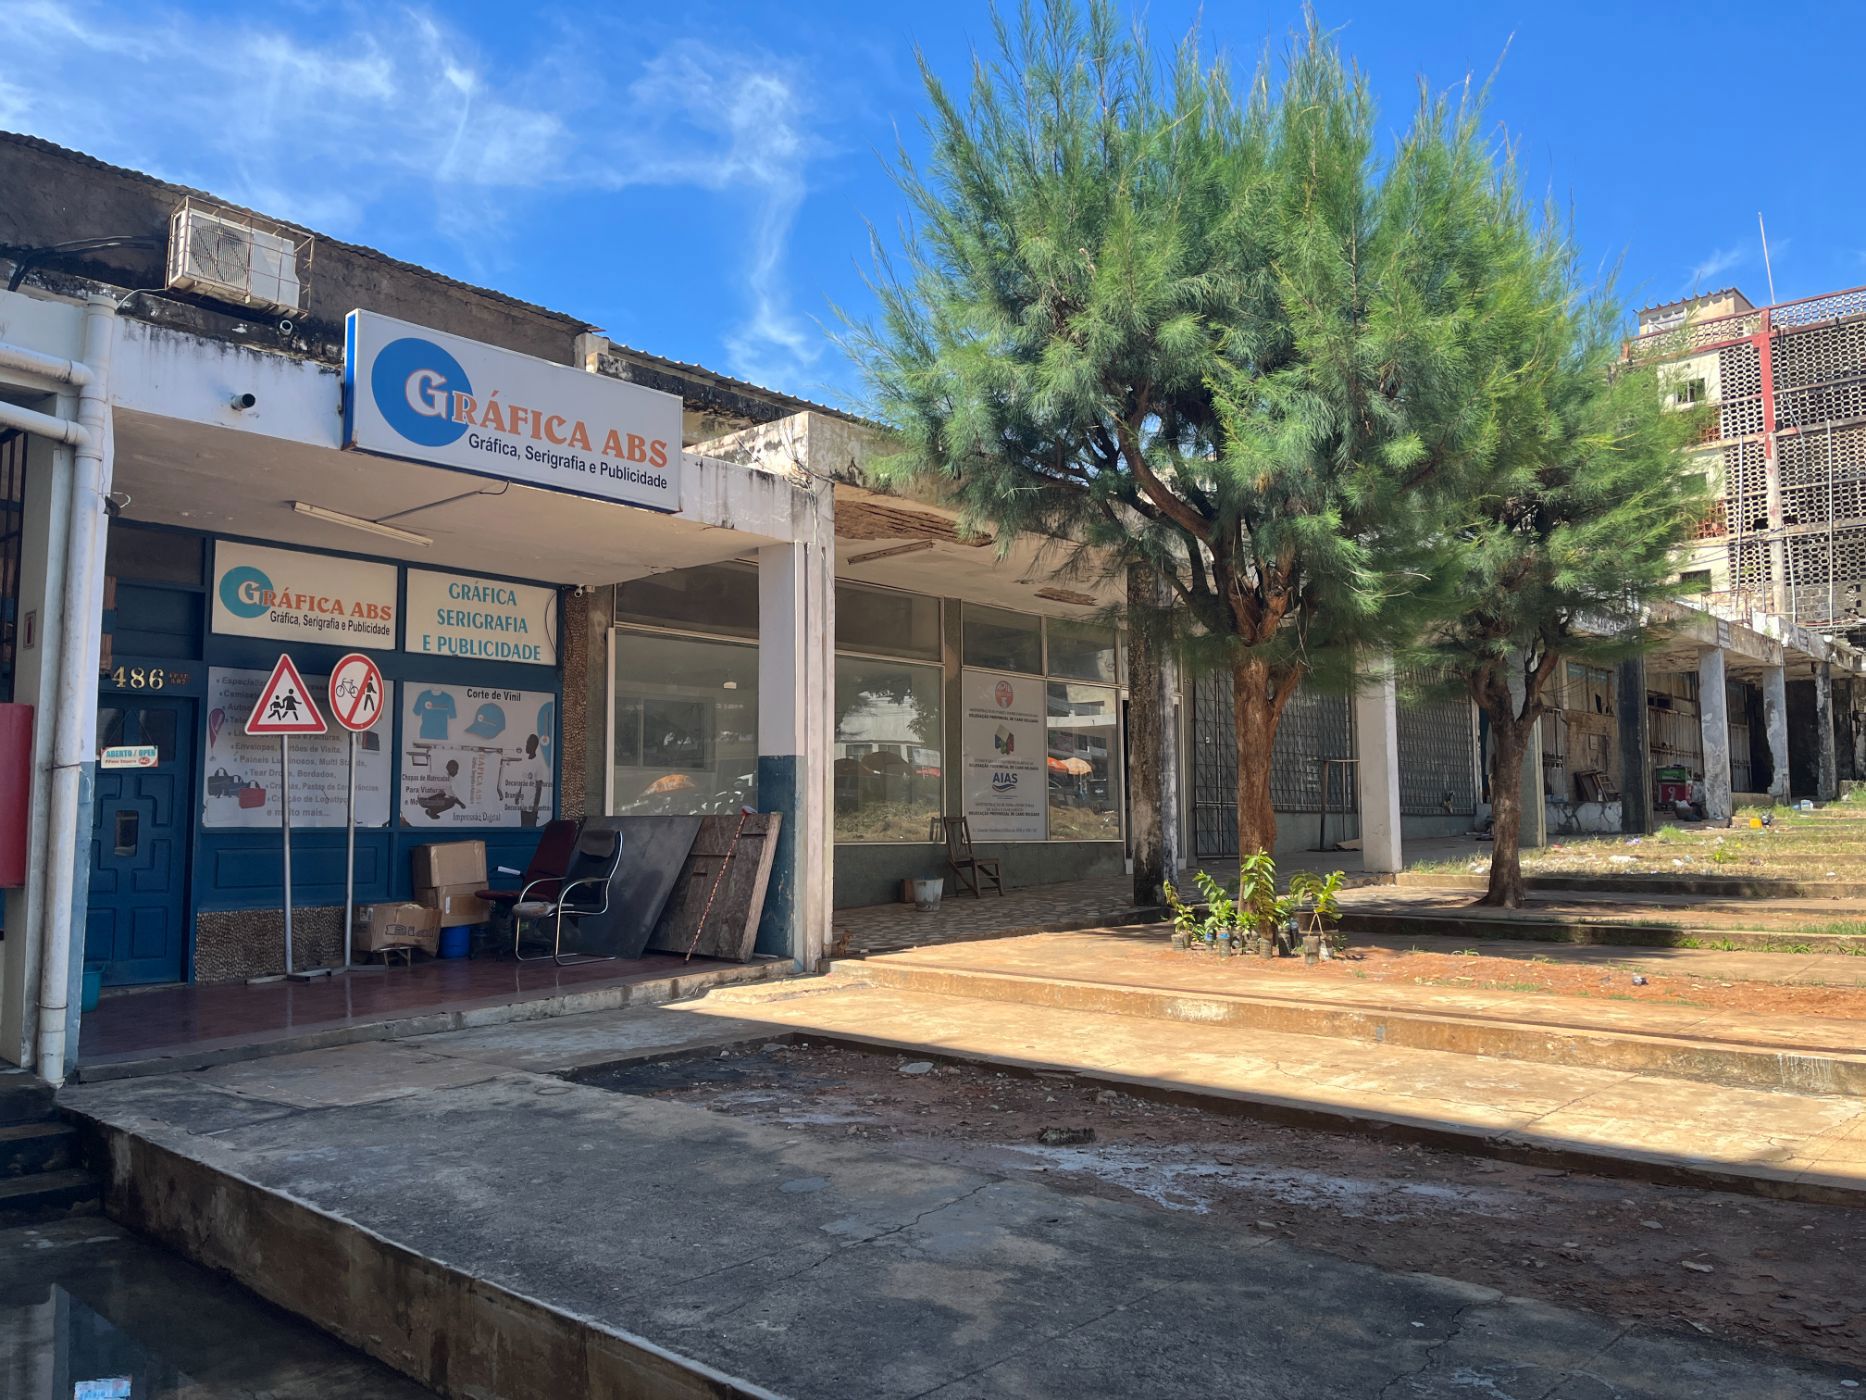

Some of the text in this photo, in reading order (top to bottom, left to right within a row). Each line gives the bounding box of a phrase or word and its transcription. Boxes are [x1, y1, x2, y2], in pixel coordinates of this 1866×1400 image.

[404, 368, 668, 468] GRÁFICA ABS
[468, 432, 668, 489] Gráfica, Serigrafia e Publicidade
[237, 579, 392, 622] GRÁFICA ABS
[448, 581, 517, 606] GRÁFICA
[270, 610, 301, 628] Gráfica,
[303, 614, 340, 631] Serigrafia
[348, 619, 390, 636] Publicidade
[437, 608, 528, 633] SERIGRAFIA
[423, 634, 541, 661] E PUBLICIDADE
[112, 666, 164, 689] 486
[466, 688, 521, 702] Corte de Vinil
[992, 772, 1018, 784] AIAS
